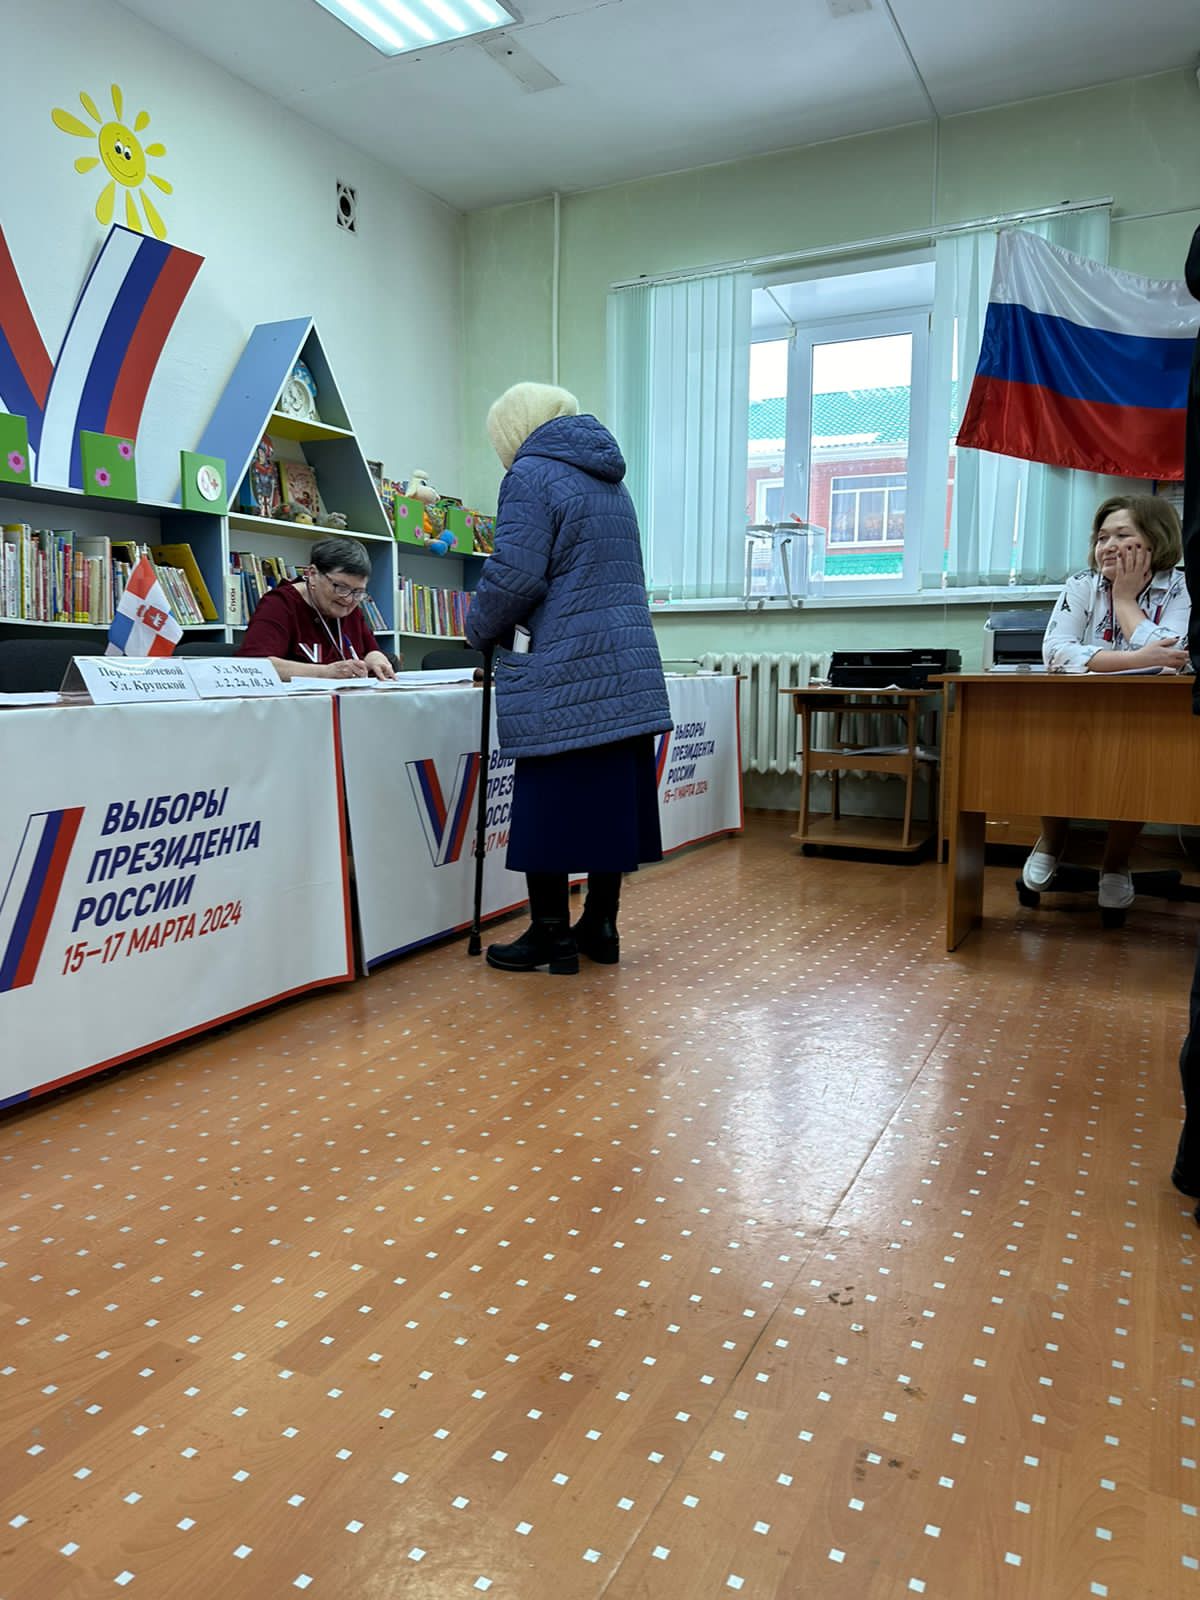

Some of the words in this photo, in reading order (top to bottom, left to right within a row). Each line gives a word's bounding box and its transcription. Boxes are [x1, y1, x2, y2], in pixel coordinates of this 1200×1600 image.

[133, 680, 186, 693] Крупской
[675, 721, 706, 740] ВЫБОРЫ
[671, 740, 715, 763] ПРЕЗИДЕНТА
[666, 764, 696, 784] РОССИИ
[100, 787, 229, 836] ВЫБОРЫ
[86, 820, 261, 884] ПРЕЗИДЕНТА
[71, 874, 196, 933] РОССИИ
[126, 913, 196, 957] МАРТА
[198, 900, 242, 936] 2024
